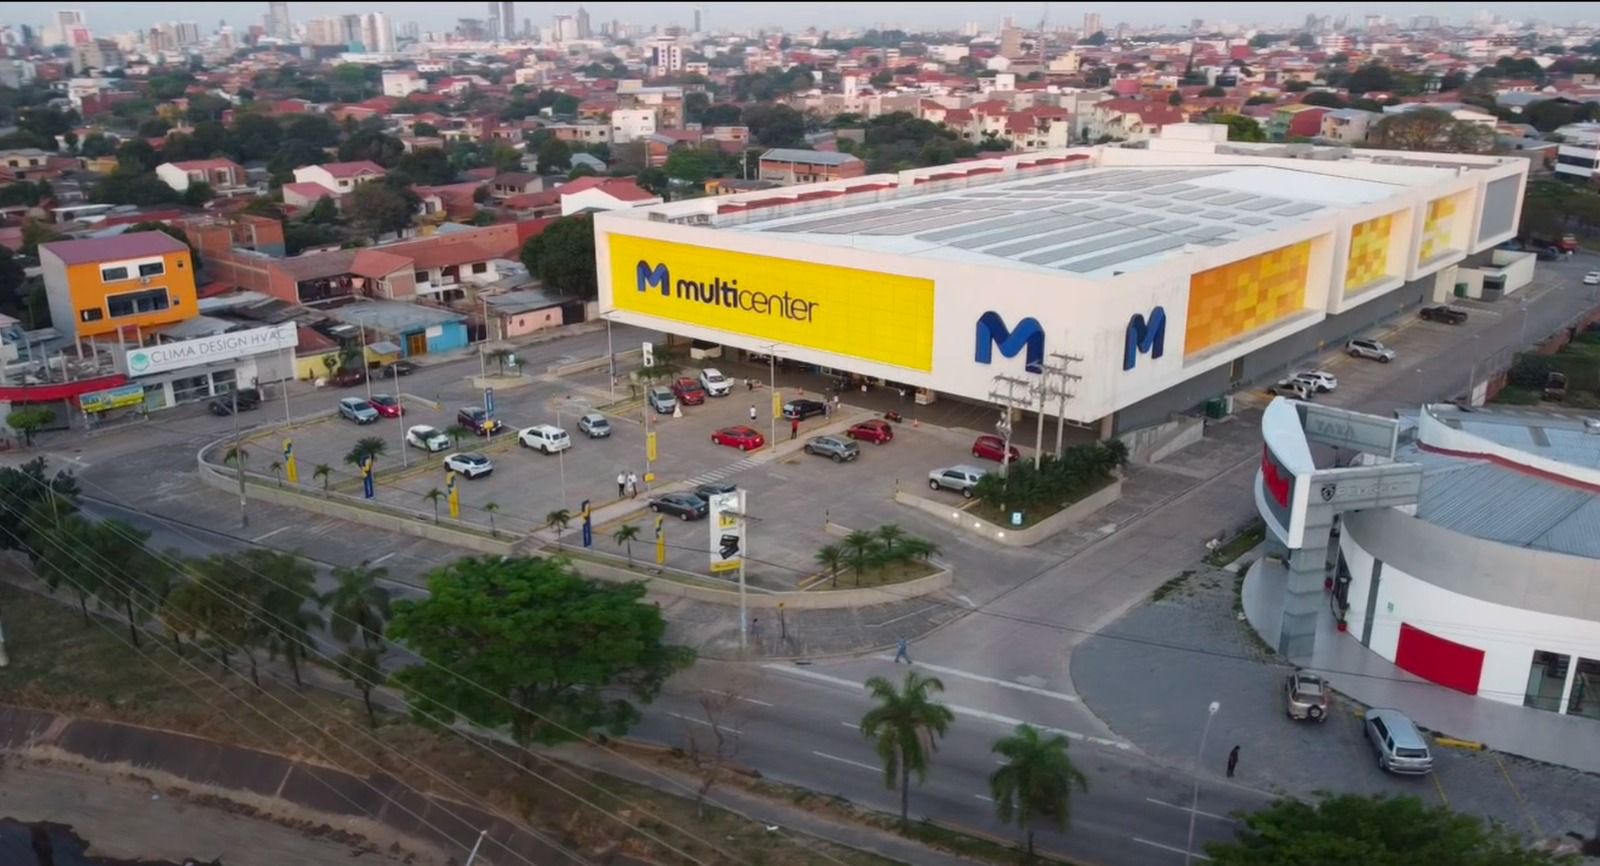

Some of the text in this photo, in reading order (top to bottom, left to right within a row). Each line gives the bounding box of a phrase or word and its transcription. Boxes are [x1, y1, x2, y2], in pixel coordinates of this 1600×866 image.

[677, 277, 819, 323] multicenter
[151, 329, 286, 364] CLIMA DESIGN HVAC
[975, 310, 1045, 374] M
[1122, 306, 1166, 371] M
